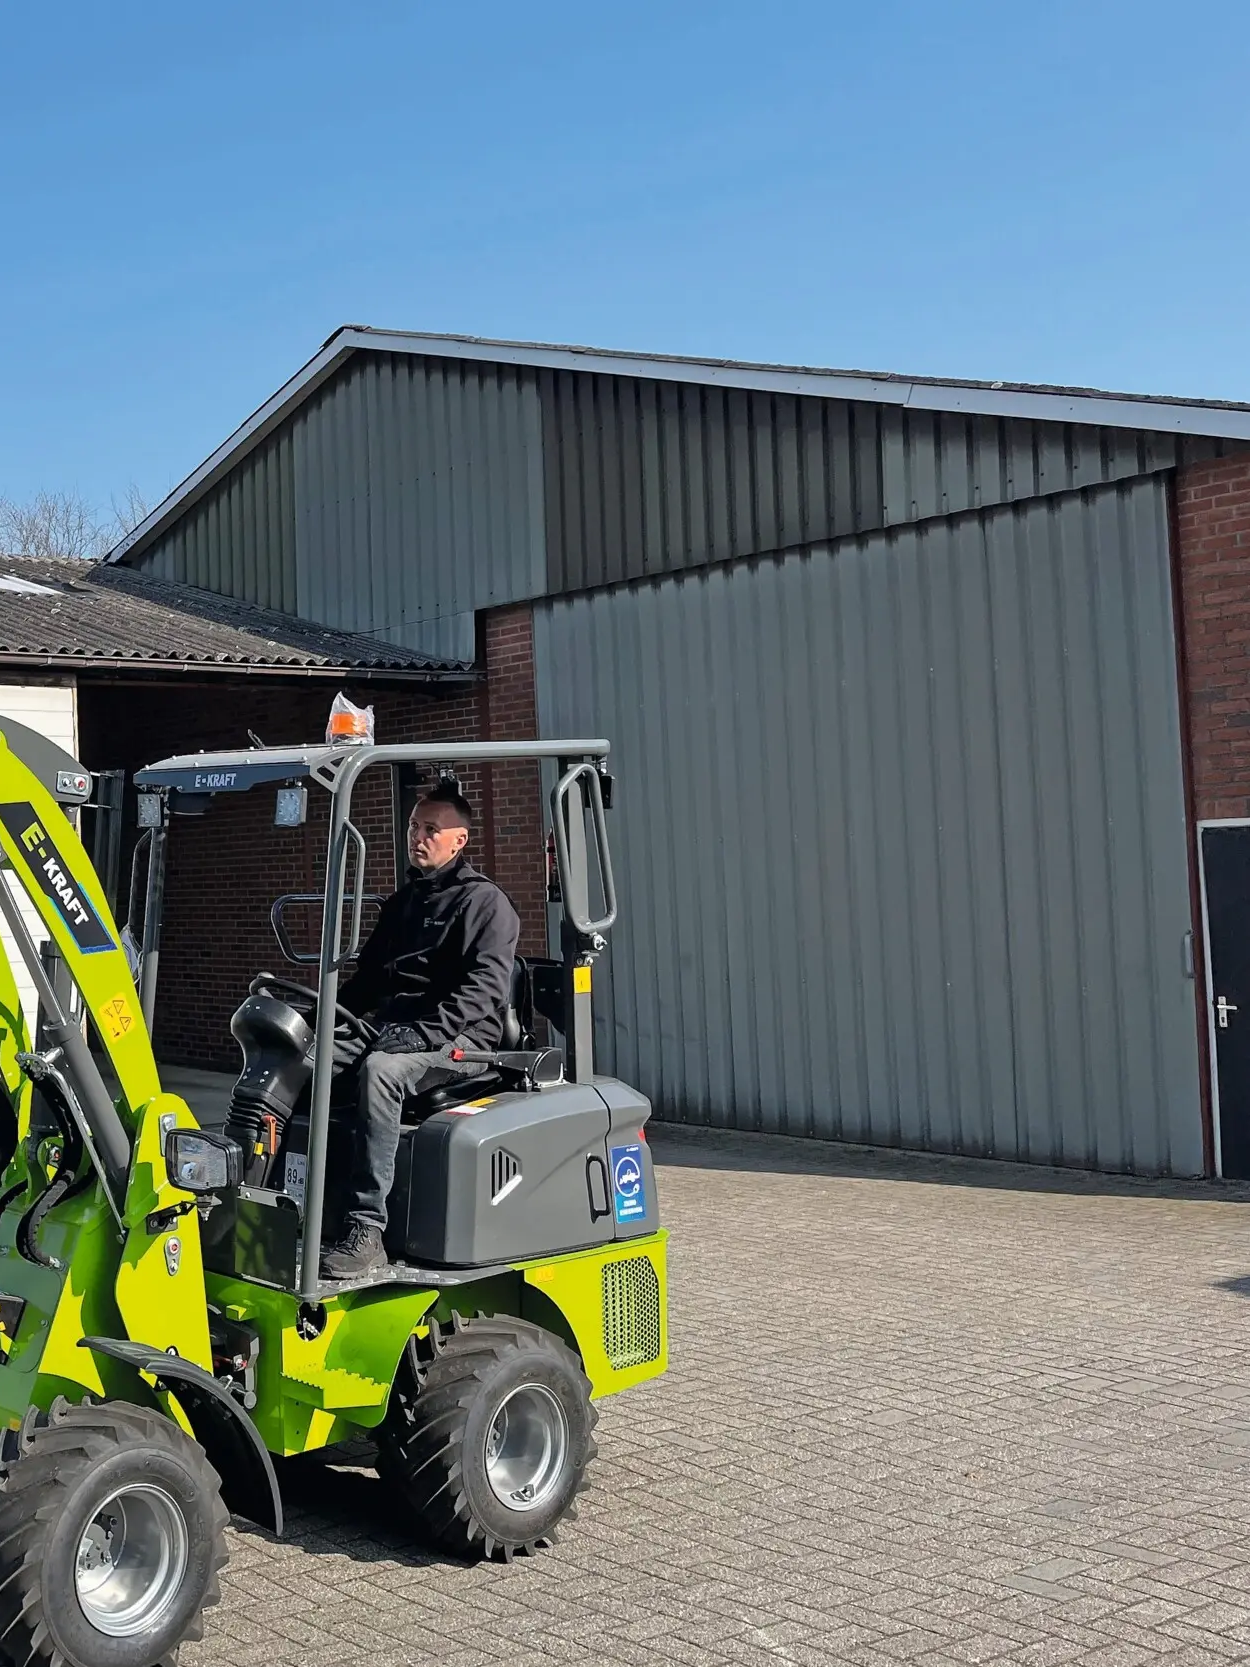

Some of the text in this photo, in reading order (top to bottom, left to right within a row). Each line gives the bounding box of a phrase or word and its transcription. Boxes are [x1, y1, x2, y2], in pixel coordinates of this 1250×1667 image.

[195, 773, 237, 788] E-KRAFT
[20, 822, 89, 926] E-KRAFT
[287, 1167, 297, 1184] 89
